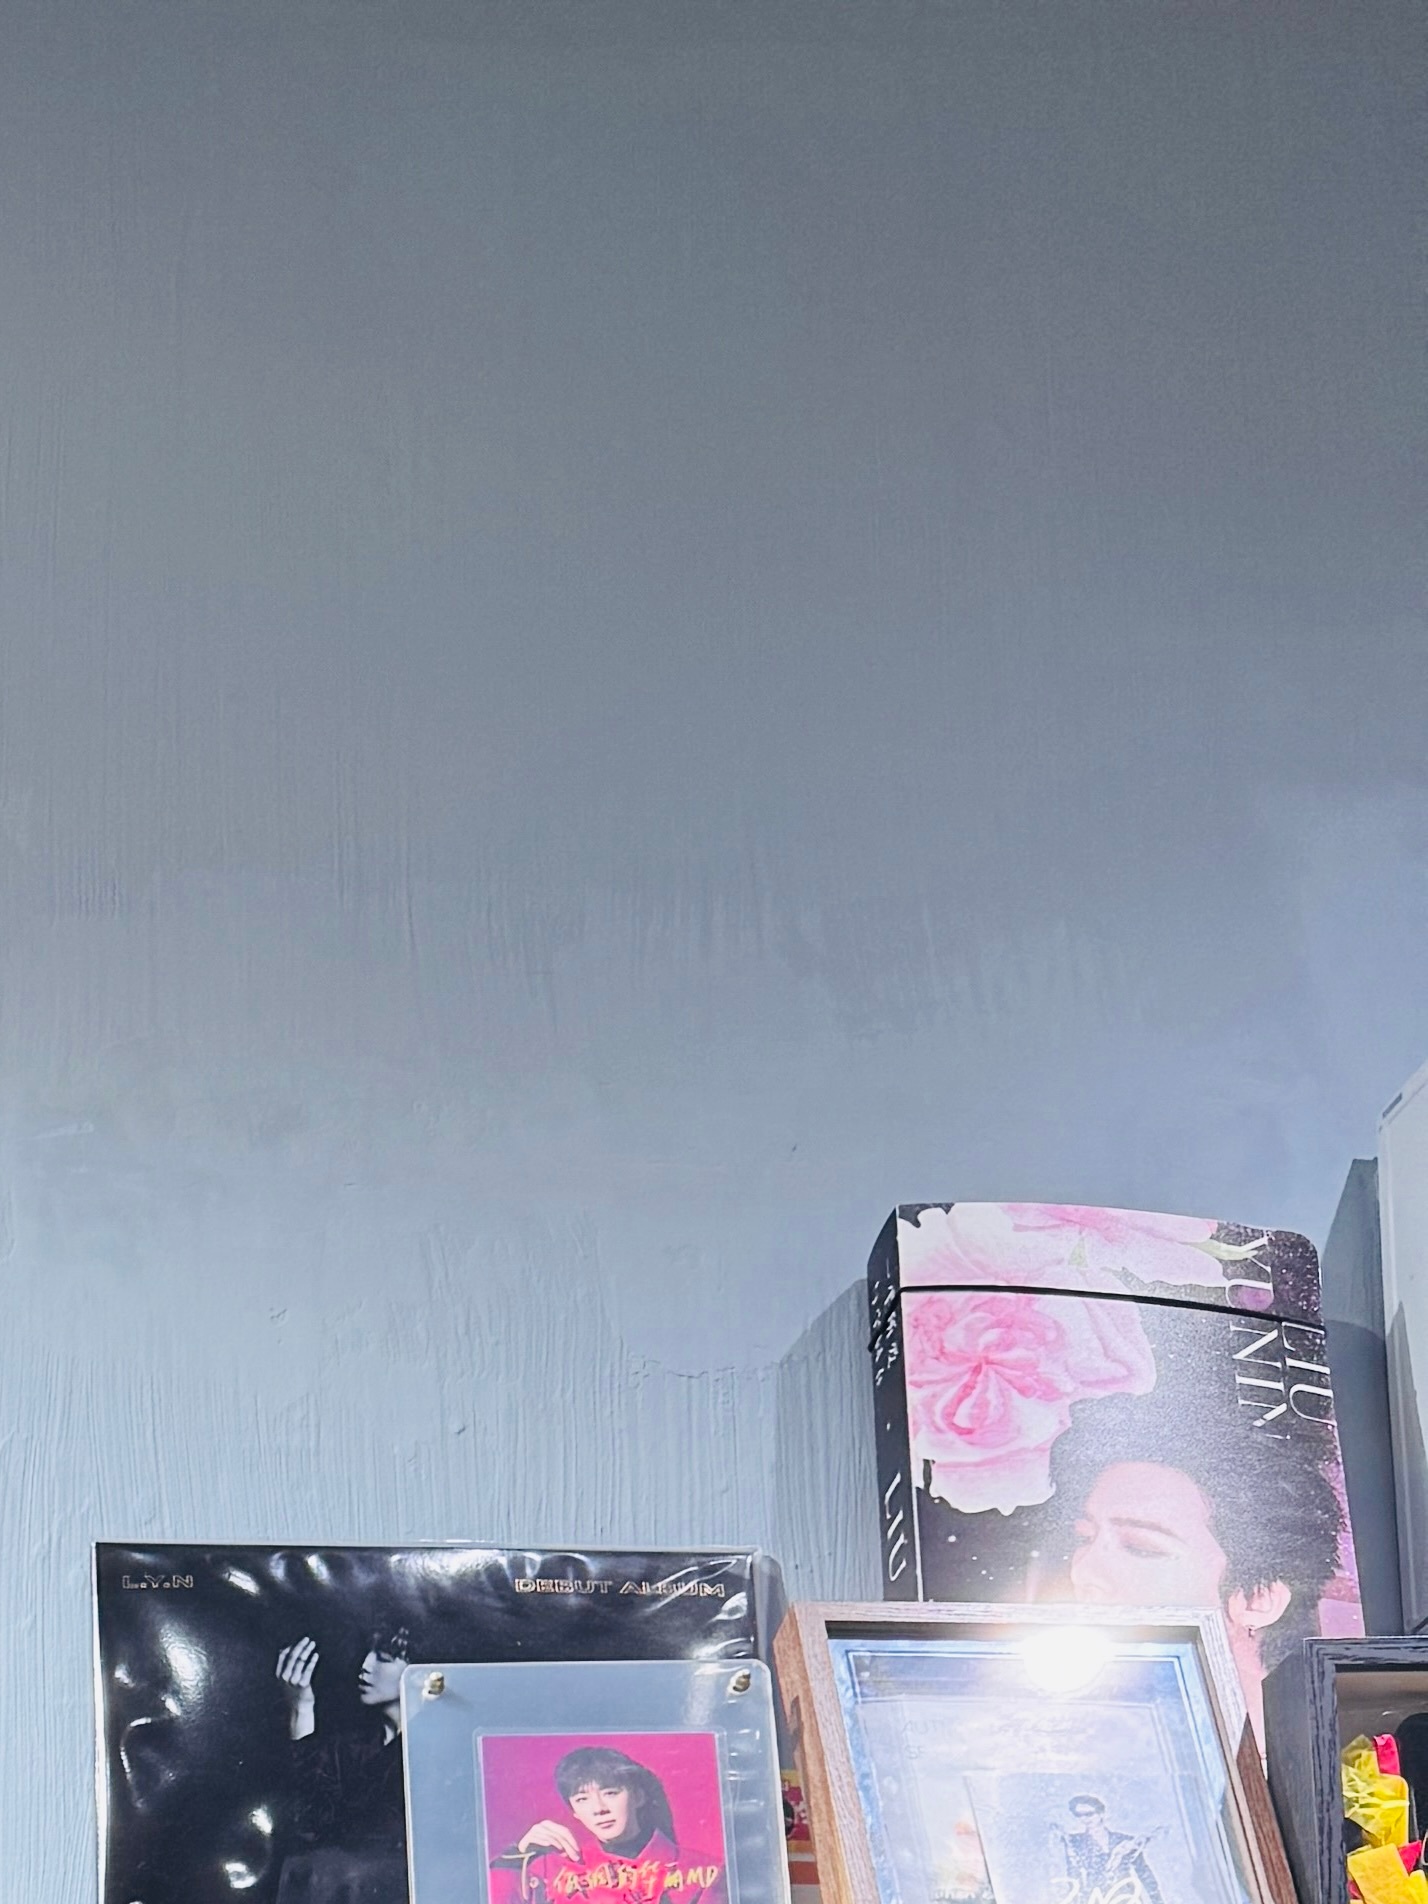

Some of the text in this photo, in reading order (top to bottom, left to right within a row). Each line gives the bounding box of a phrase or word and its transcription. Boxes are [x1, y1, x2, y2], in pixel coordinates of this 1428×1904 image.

[1282, 1321, 1338, 1427] LIU
[514, 1577, 726, 1599] DEBUT ALBUM
